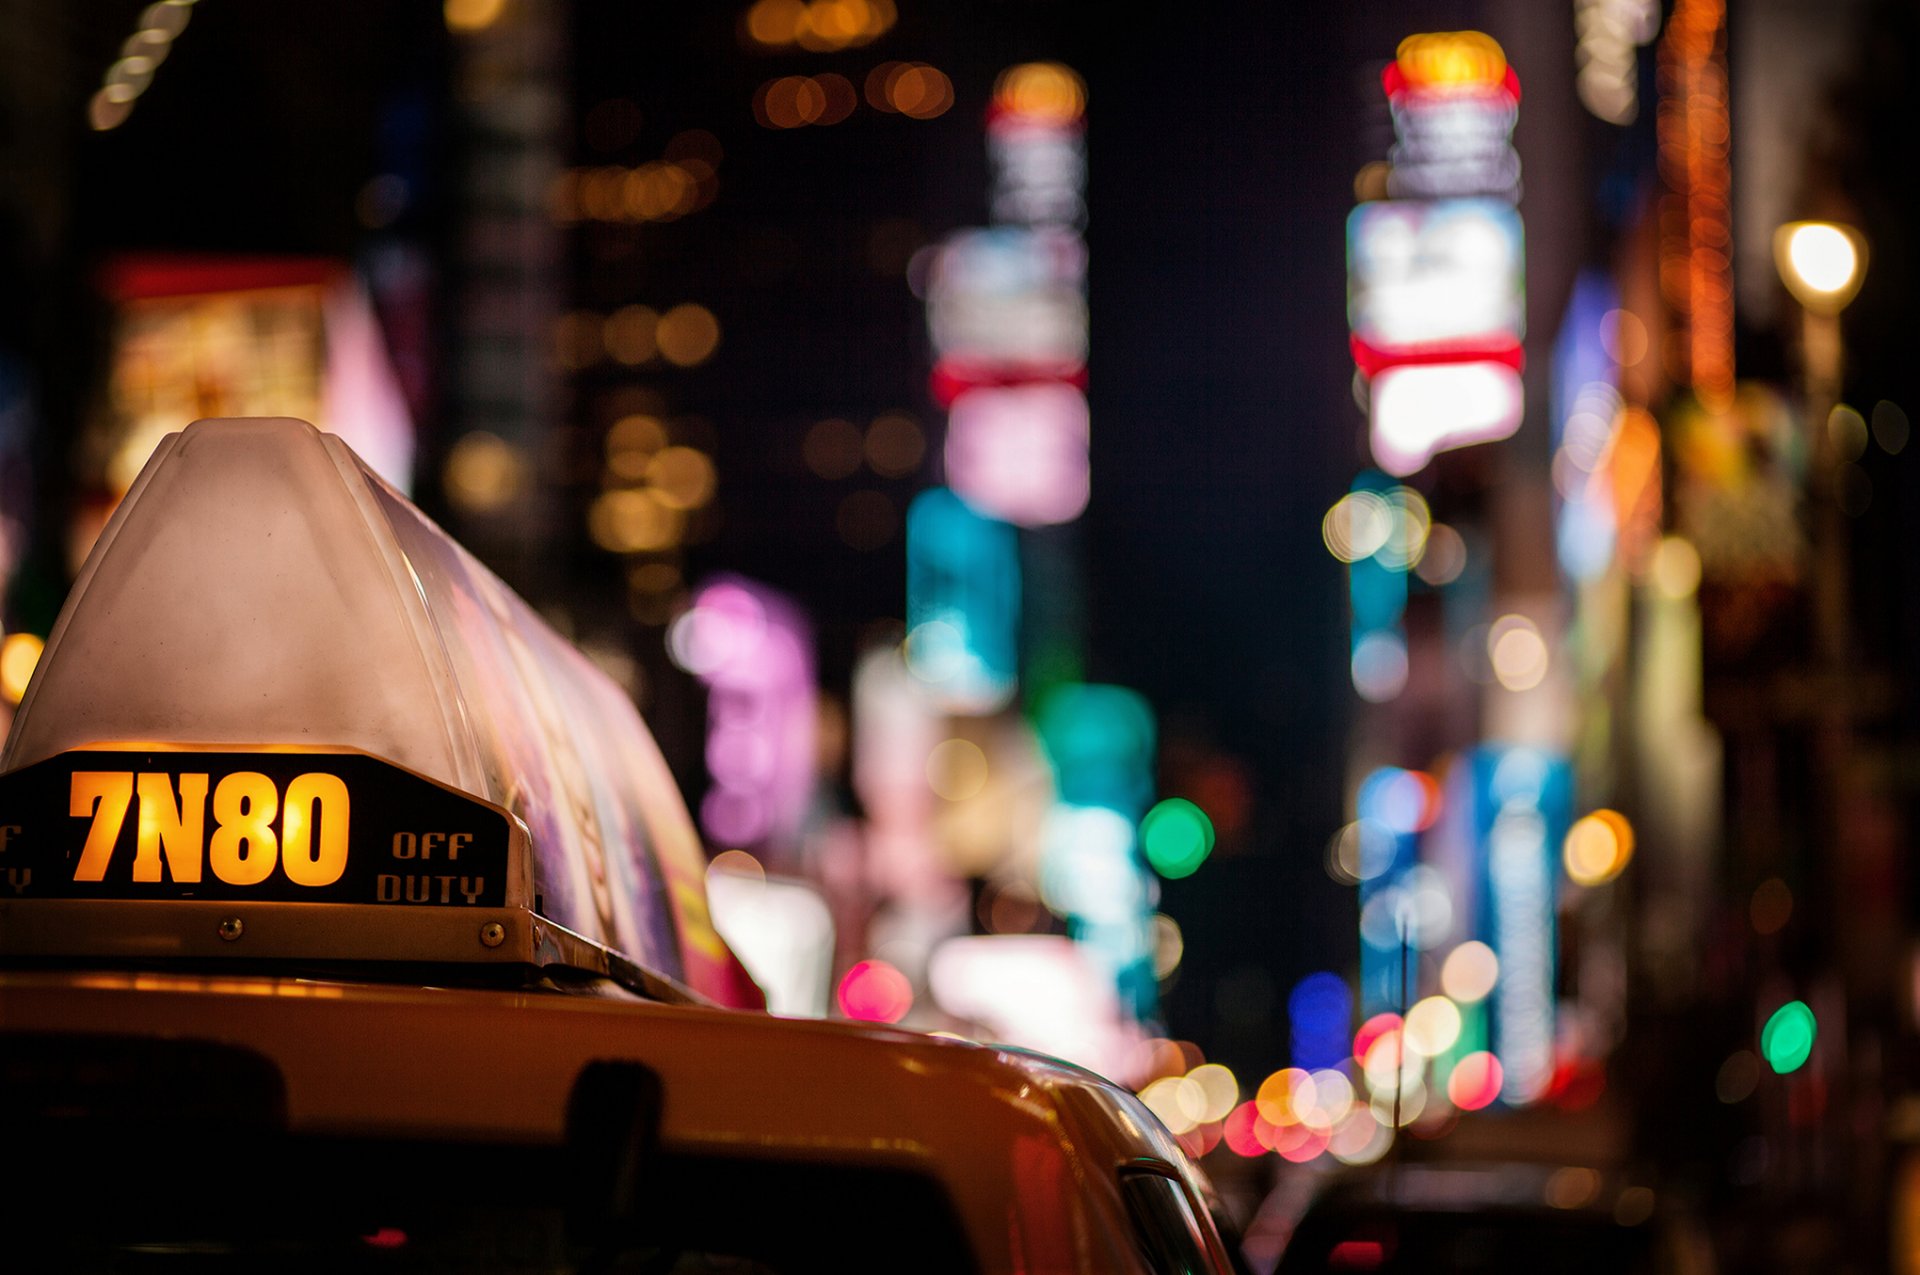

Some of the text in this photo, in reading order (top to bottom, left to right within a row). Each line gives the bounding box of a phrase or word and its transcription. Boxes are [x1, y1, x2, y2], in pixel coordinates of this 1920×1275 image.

[69, 771, 350, 886] 7N80
[392, 832, 473, 860] OFF
[377, 874, 484, 904] DUTY
